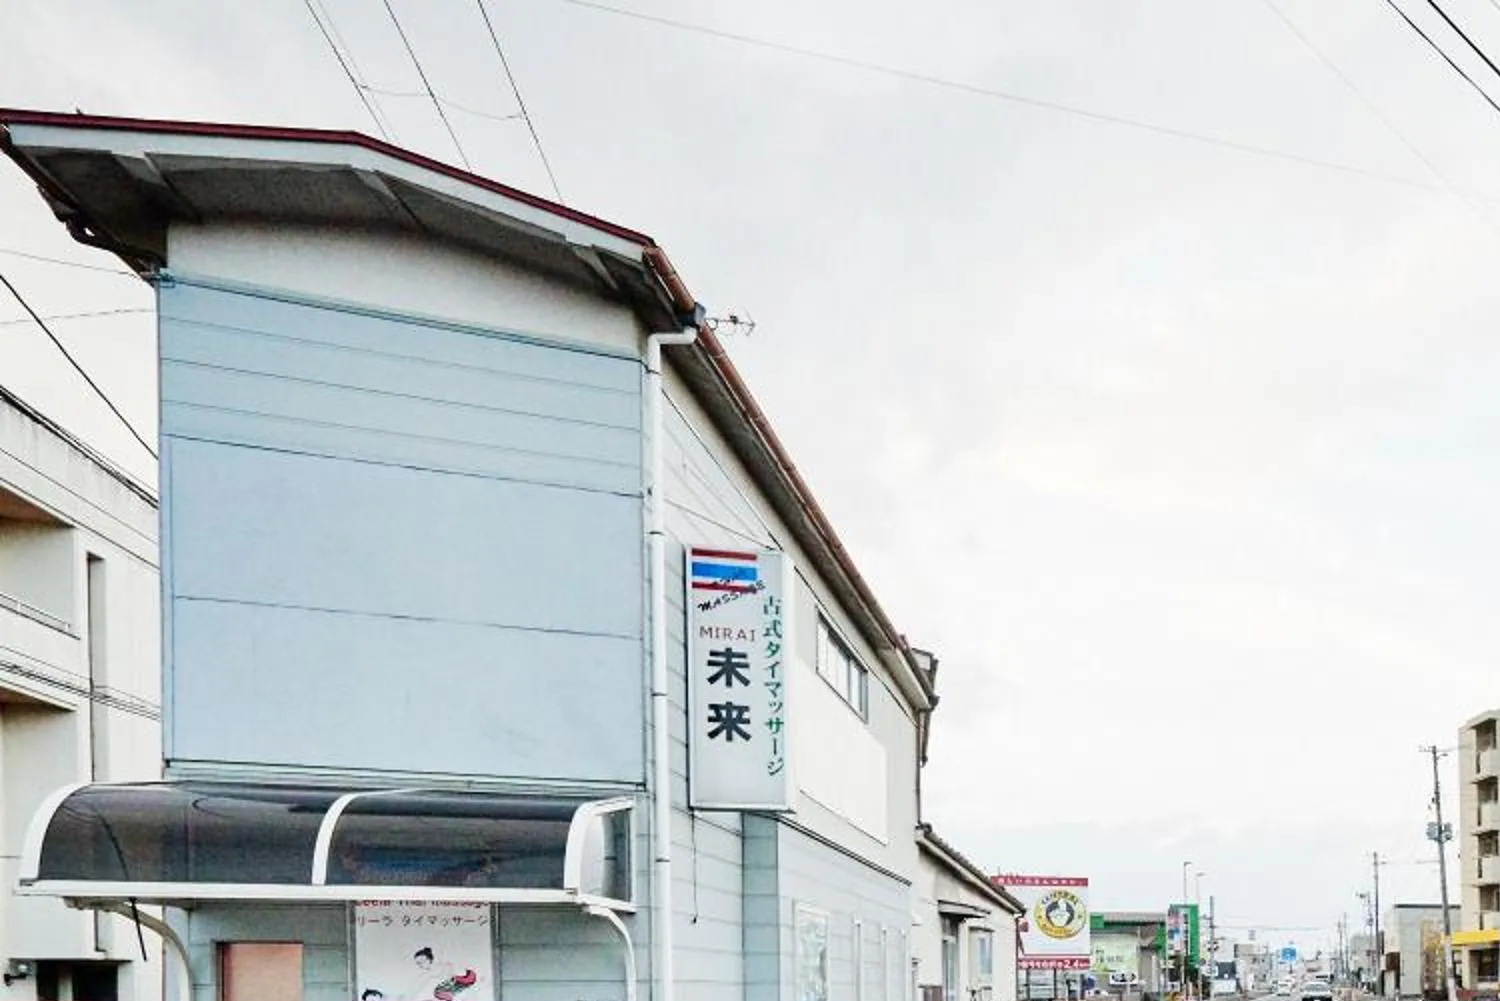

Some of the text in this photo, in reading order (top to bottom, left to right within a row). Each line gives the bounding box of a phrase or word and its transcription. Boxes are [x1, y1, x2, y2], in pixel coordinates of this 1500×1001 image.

[699, 625, 757, 643] MIRAI
[706, 647, 752, 743] 未来
[762, 595, 785, 778] 古式タイマッサージ
